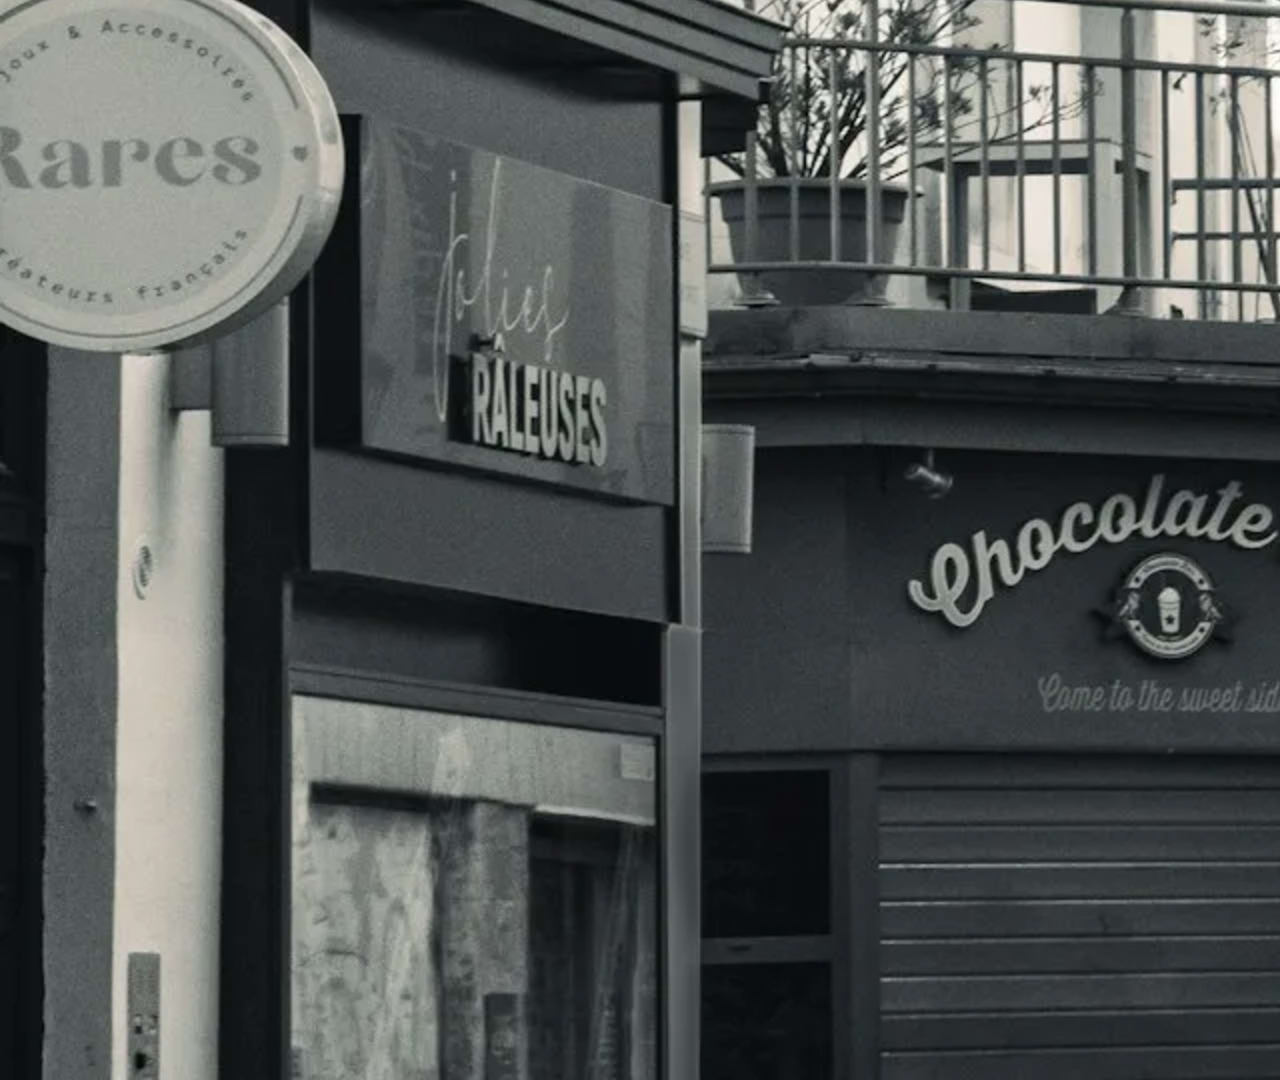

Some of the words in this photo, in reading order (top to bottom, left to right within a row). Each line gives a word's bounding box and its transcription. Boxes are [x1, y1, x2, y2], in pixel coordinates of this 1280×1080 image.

[67, 25, 82, 40] &
[101, 19, 254, 103] Accessoires
[136, 229, 248, 301] français
[472, 331, 608, 467] RÂLEUSES
[908, 474, 1280, 628] Chocolate
[1037, 672, 1105, 713] Come
[1108, 679, 1135, 712] to
[1137, 679, 1174, 712] the
[1176, 680, 1244, 713] sweet
